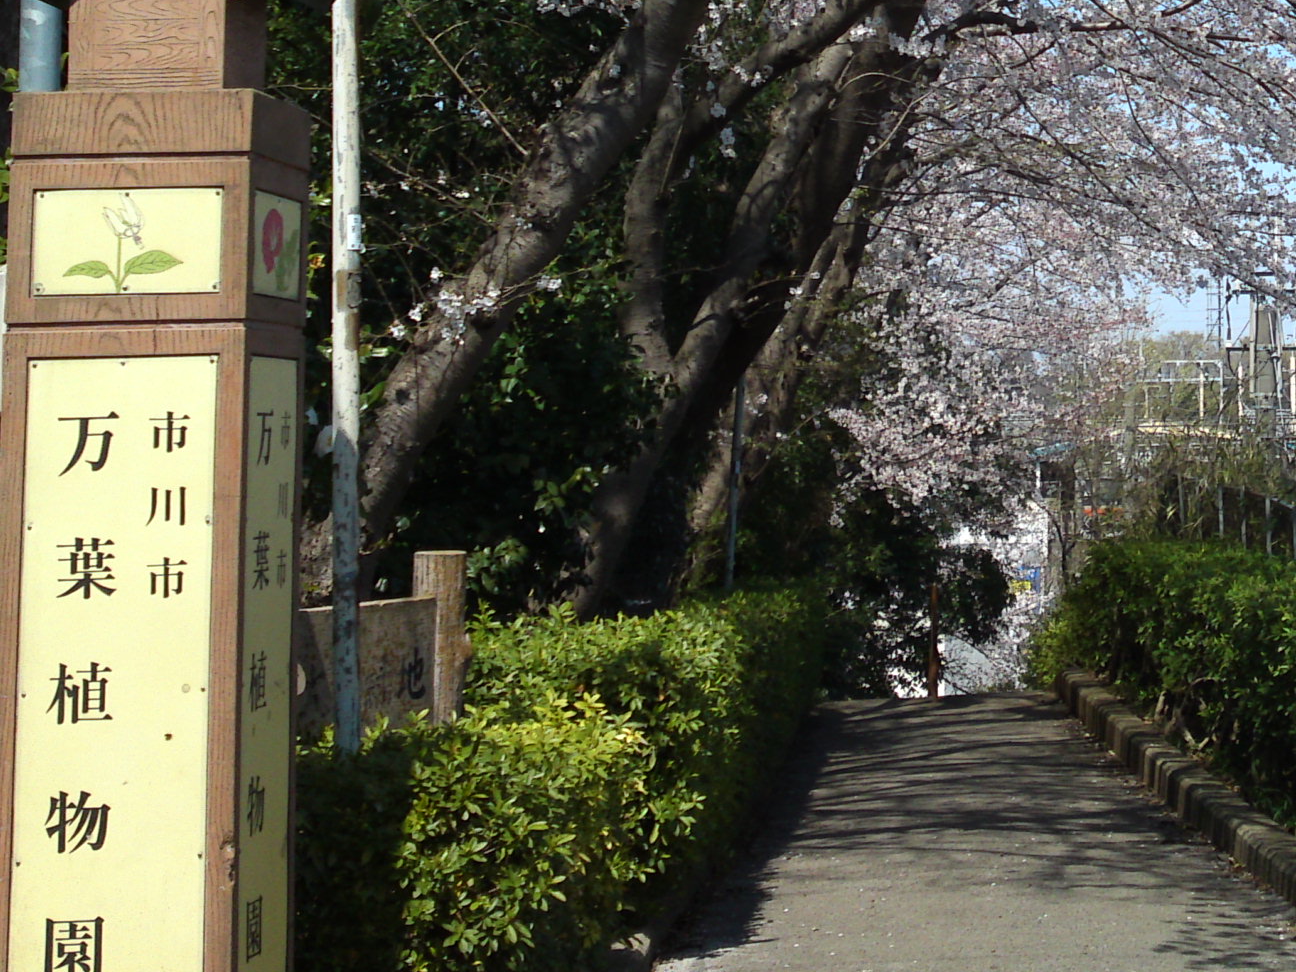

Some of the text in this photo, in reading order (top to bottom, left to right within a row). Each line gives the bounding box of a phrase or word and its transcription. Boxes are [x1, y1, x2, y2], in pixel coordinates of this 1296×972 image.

[146, 411, 191, 599] 市川市
[246, 408, 275, 964] 万葉植物園
[277, 410, 292, 590] 市川市
[43, 411, 120, 972] 万葉植物園
